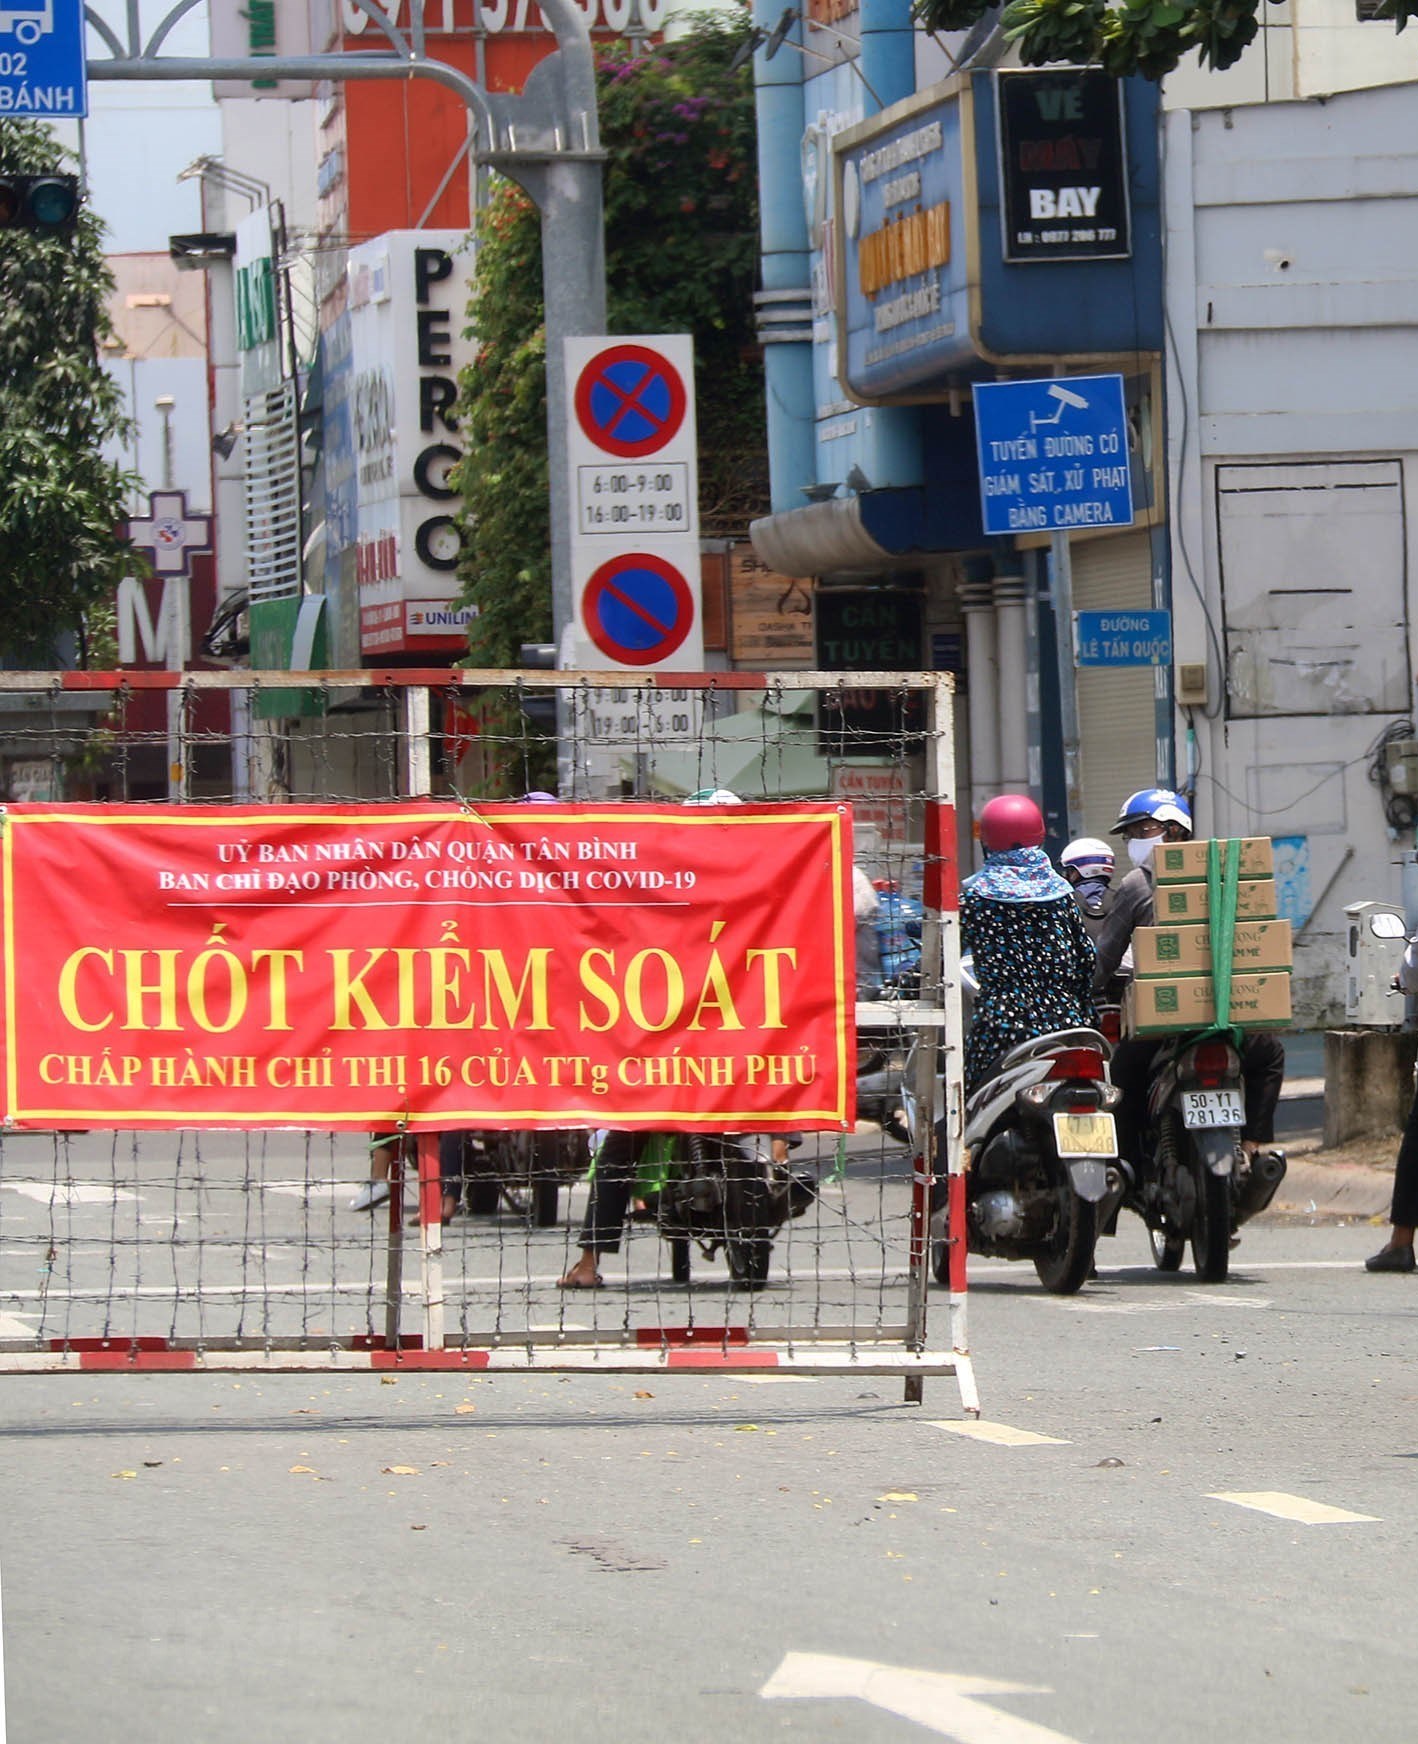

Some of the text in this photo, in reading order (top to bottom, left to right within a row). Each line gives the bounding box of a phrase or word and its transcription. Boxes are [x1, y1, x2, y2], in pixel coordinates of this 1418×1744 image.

[0, 80, 74, 110] BÁNH
[1029, 186, 1101, 220] BAY
[990, 430, 1039, 462] TUYẾN
[1099, 427, 1119, 454] CÓ
[984, 468, 1022, 496] GIÁM
[1092, 466, 1127, 491] PHẠT
[1053, 501, 1114, 525] CAMERA
[259, 843, 309, 864] BAN
[315, 838, 385, 861] NHÂN
[391, 836, 441, 860] DÂN
[447, 838, 514, 864] QUẬN
[520, 836, 572, 860] TÂN
[577, 836, 637, 860] BÌNH
[159, 872, 210, 891] BAN
[267, 871, 321, 894] ĐẠO
[327, 865, 420, 890] PHÒNG,
[425, 862, 513, 890] CHỐNG
[519, 871, 580, 894] DỊCH
[586, 870, 696, 890] COVID-19
[58, 919, 798, 1033] CHỐT KIỂM SOÁT
[38, 1046, 818, 1094] CHẤP HÀNH CHỈ THỊ 16 CỦA TTg CHÍNH PHỦ
[1190, 1093, 1232, 1110] 50-Y1
[1187, 1108, 1241, 1126] 281.36
